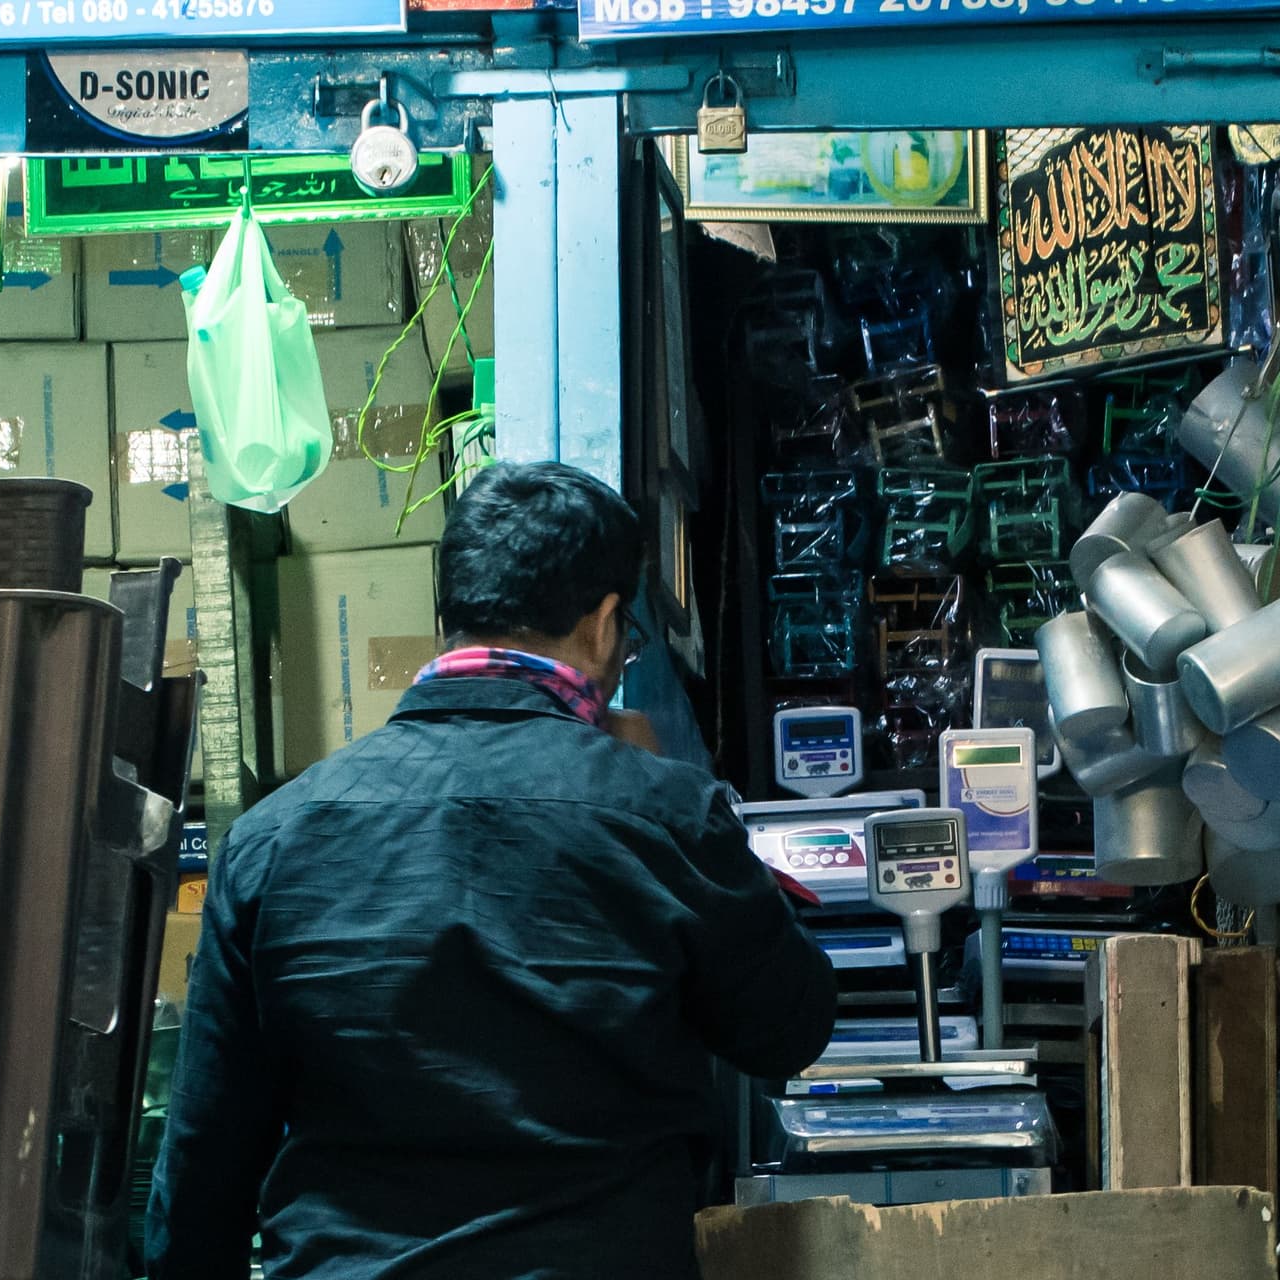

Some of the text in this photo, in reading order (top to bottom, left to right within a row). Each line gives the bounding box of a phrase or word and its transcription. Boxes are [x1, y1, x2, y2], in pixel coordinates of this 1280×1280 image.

[40, 0, 74, 24] Tel
[82, 0, 128, 23] 080
[80, 70, 210, 101] D-SONIC
